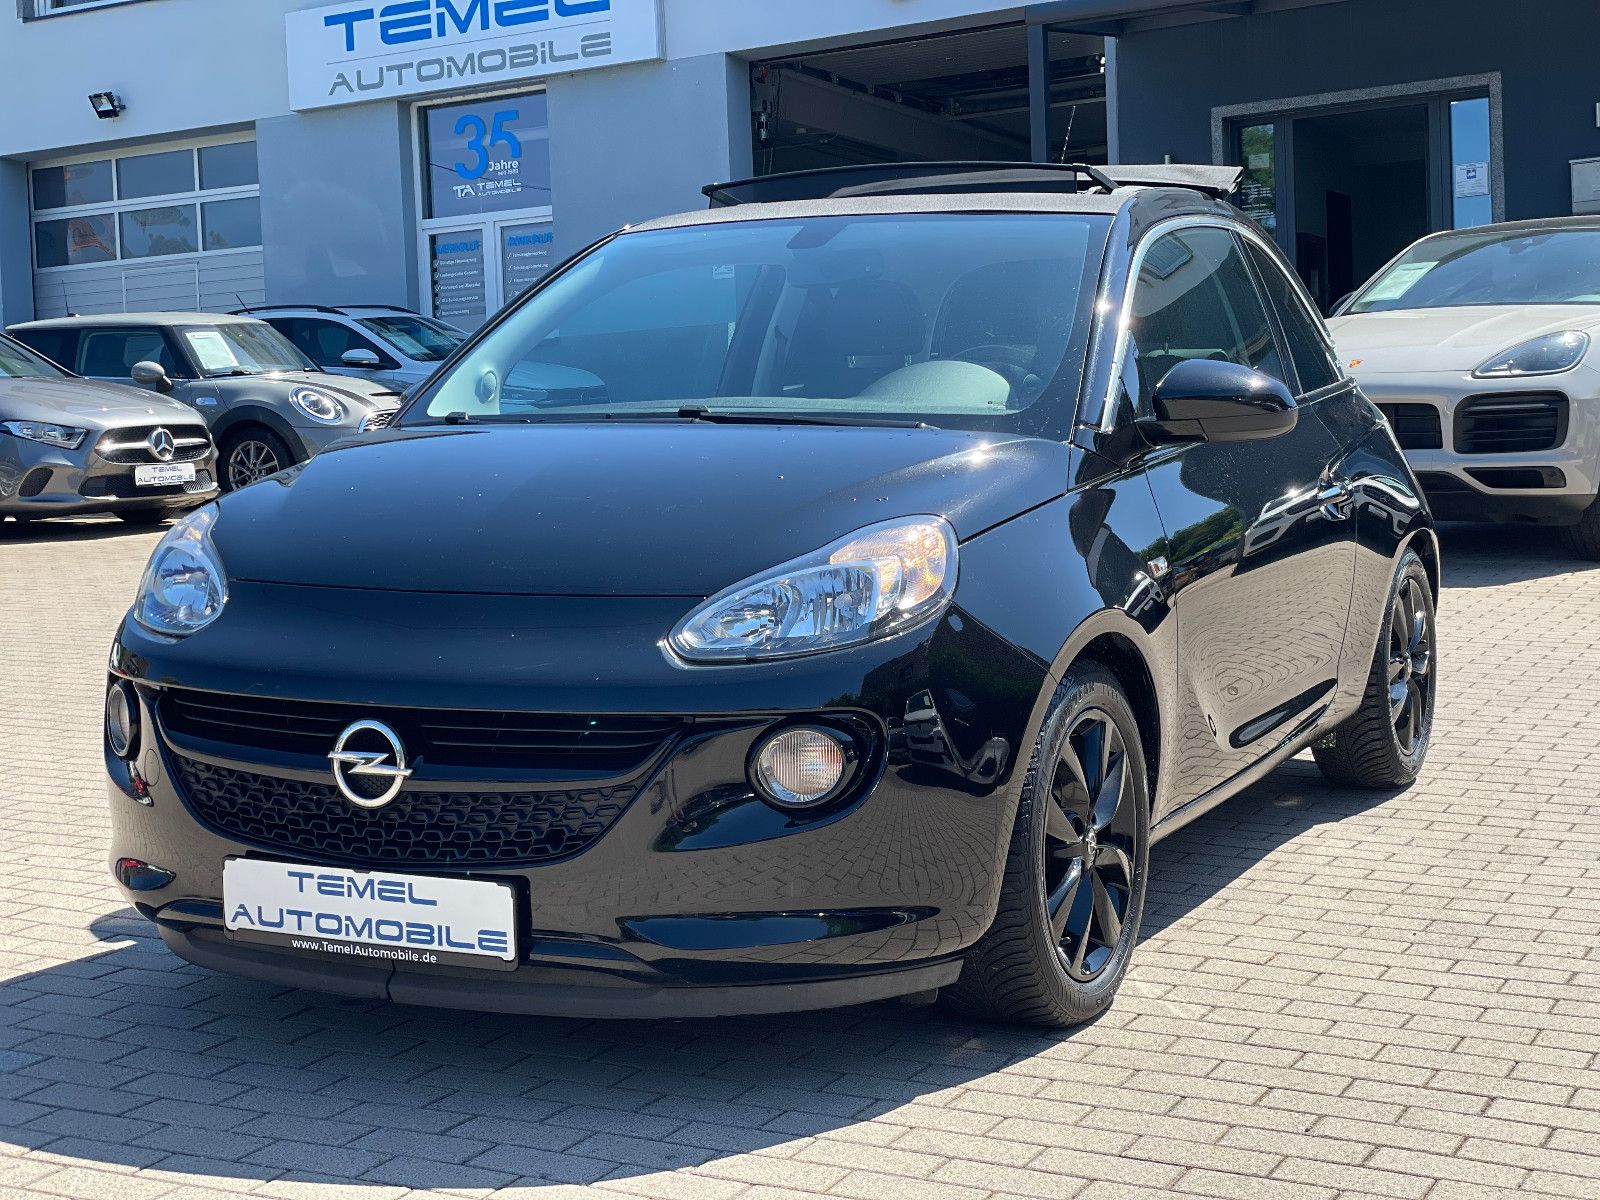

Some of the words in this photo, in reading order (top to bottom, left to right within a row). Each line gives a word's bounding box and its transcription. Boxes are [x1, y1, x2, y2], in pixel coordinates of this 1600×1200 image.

[454, 110, 521, 179] 35
[488, 159, 519, 172] Jahre
[476, 178, 522, 191] TEMEL
[287, 870, 438, 907] TEMEL
[230, 903, 508, 953] AUTOMOBILE
[291, 937, 437, 964] www.TemelAutomobile.de
